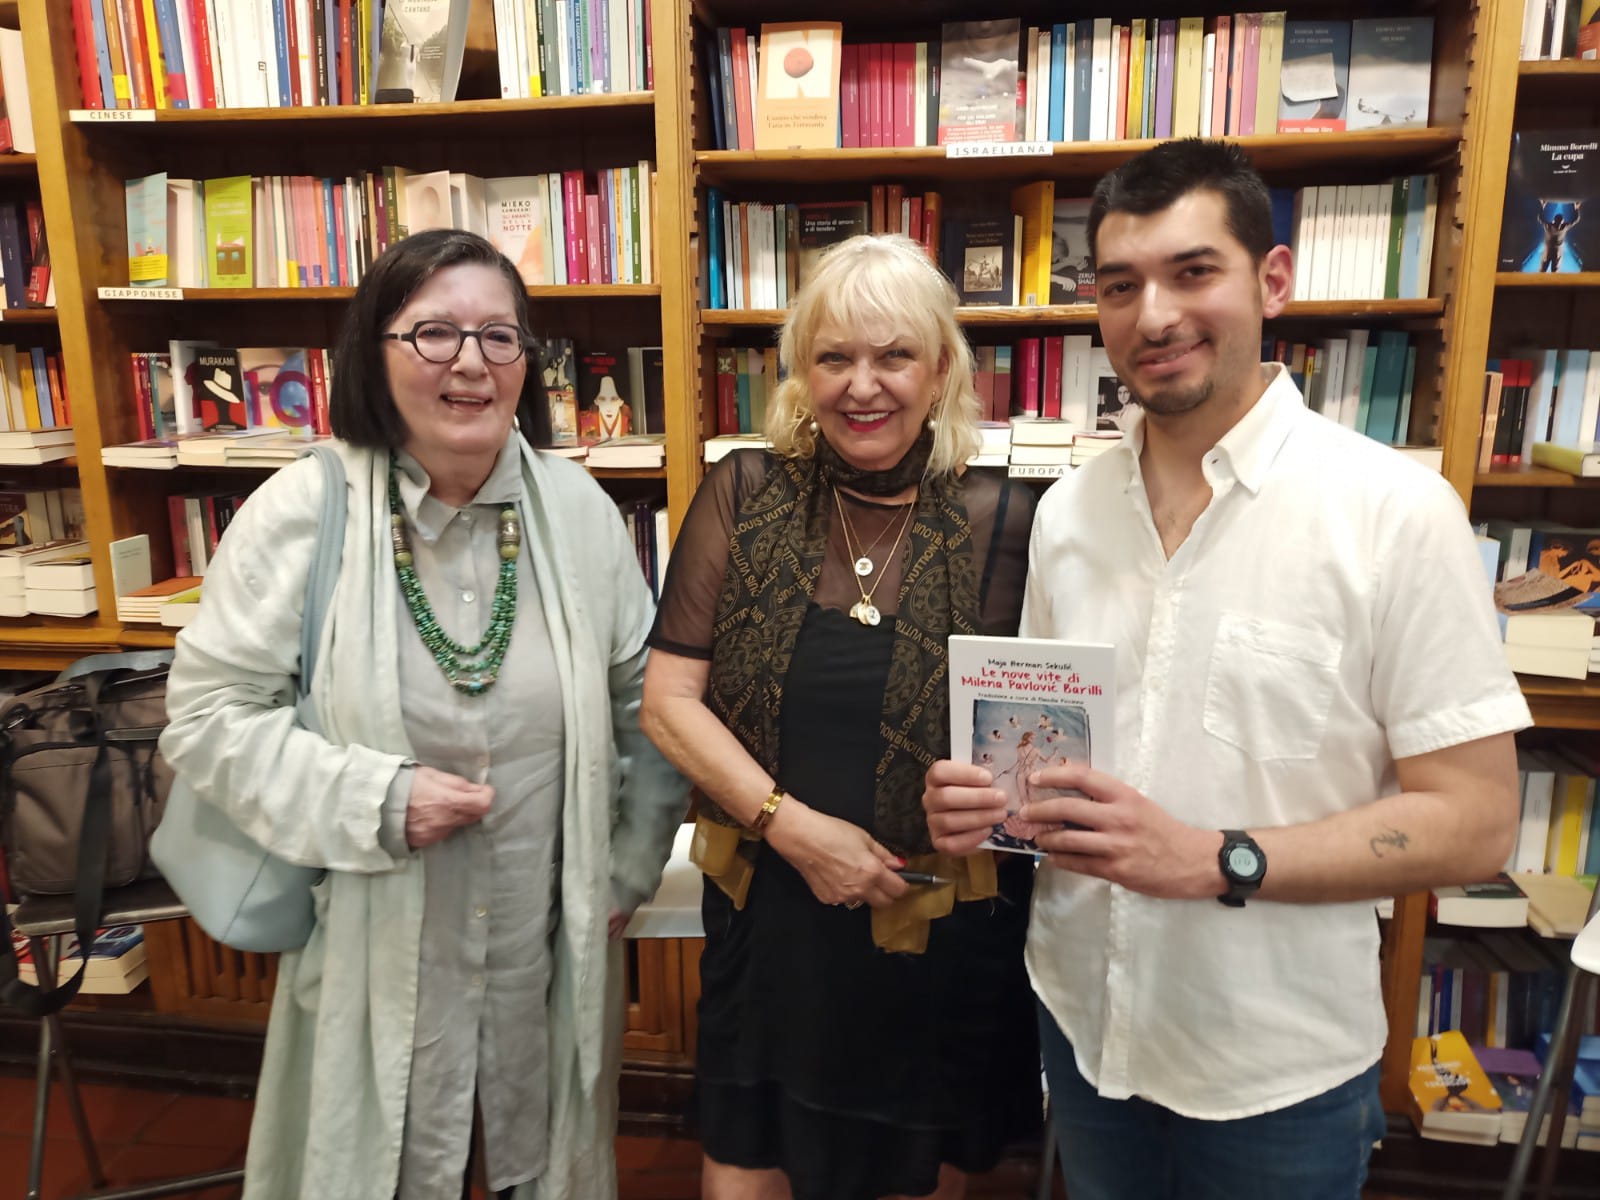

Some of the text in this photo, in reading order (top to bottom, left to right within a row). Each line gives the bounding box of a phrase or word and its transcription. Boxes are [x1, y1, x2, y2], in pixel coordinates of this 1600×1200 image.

[90, 111, 133, 120] CINESE
[955, 145, 1046, 156] ISRAELIANA
[1570, 142, 1598, 150] Borrelli
[1551, 152, 1584, 162] La cupa
[503, 224, 532, 232] NOTTE
[104, 289, 179, 299] GIAPPONESE
[199, 356, 236, 366] MURAKAMI
[1009, 466, 1065, 476] EUROPA
[733, 516, 764, 535] LOUIS
[1010, 660, 1043, 669] Herman
[981, 667, 1080, 683] Le nove vite di
[961, 676, 1103, 696] Milena Pavlović Barilli
[902, 703, 924, 736] LOUIS
